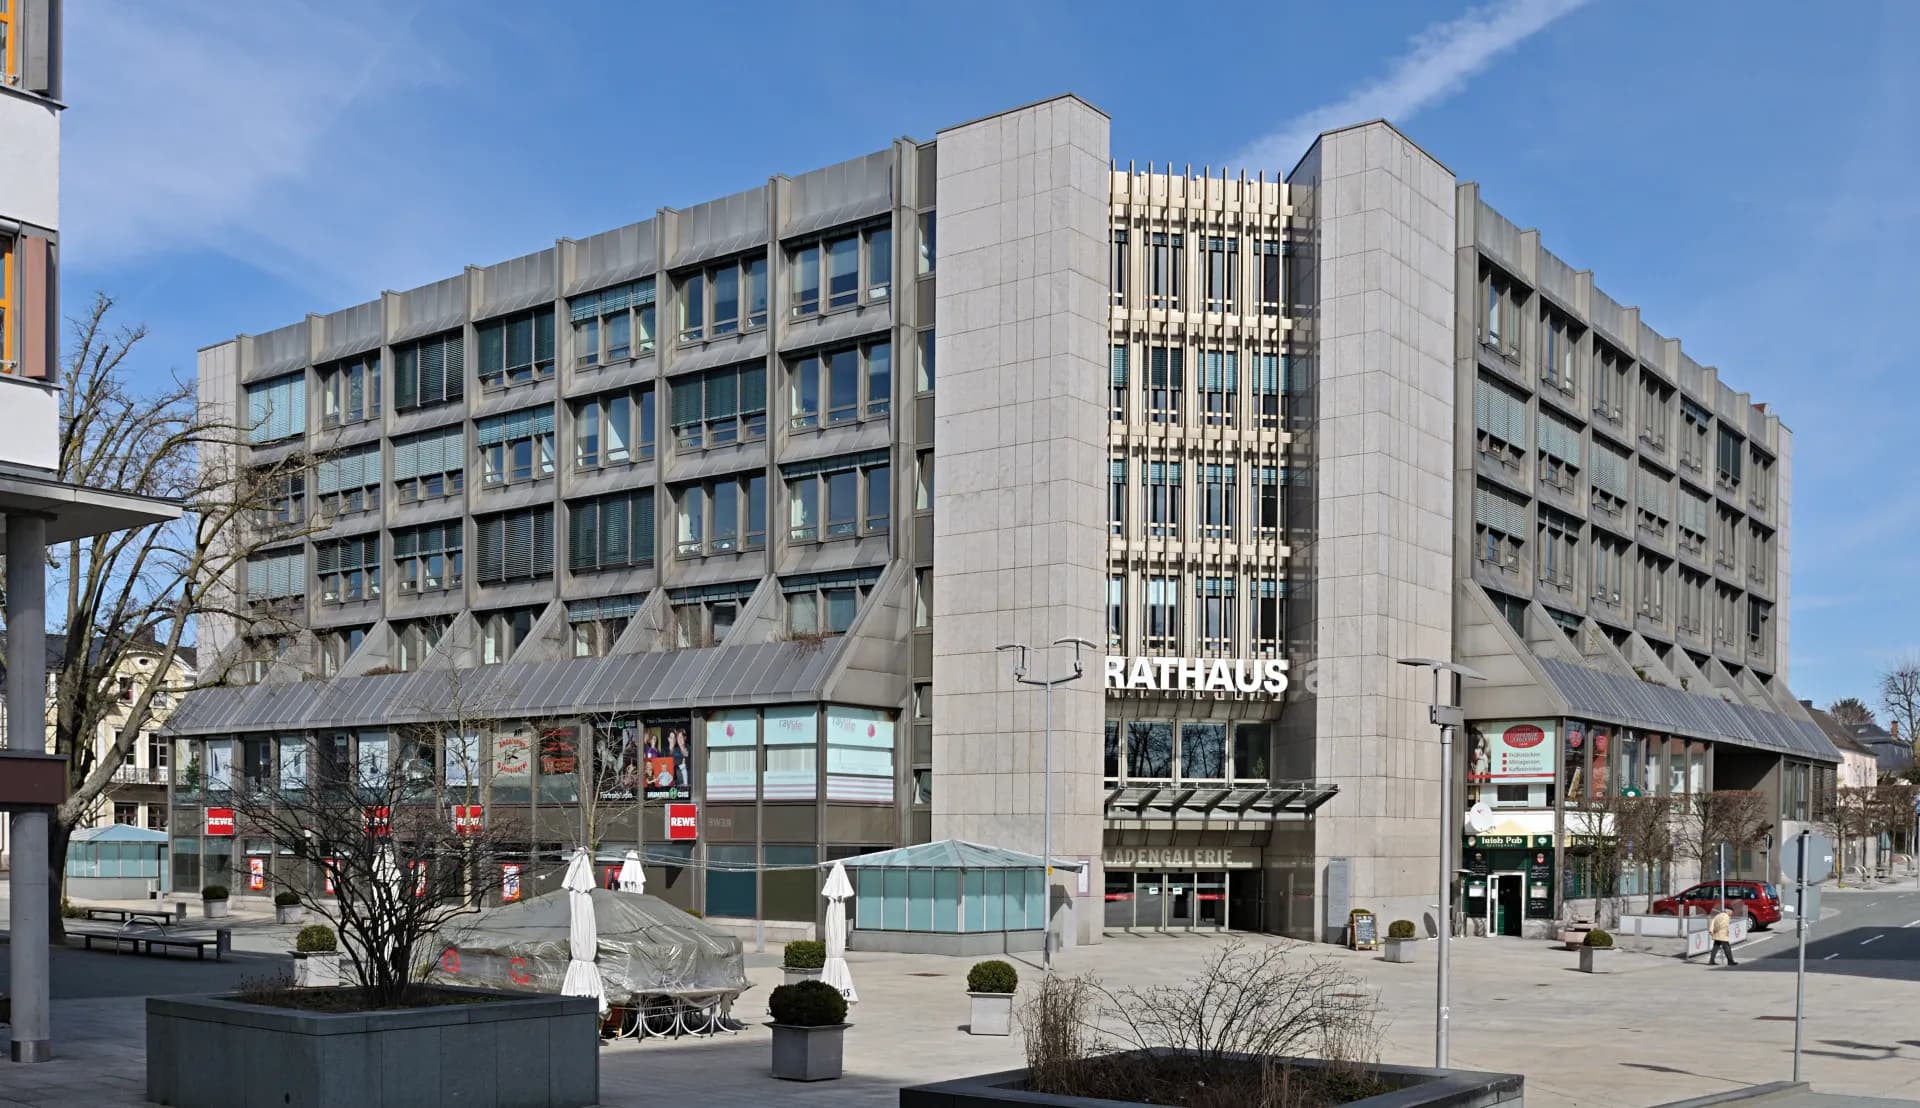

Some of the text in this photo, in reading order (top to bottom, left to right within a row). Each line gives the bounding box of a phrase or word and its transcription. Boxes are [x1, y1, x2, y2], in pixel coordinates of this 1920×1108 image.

[1104, 656, 1288, 694] RATHAUS
[208, 817, 233, 826] REWE
[670, 817, 696, 827] REWE
[1103, 849, 1233, 865] LADENGALERIE
